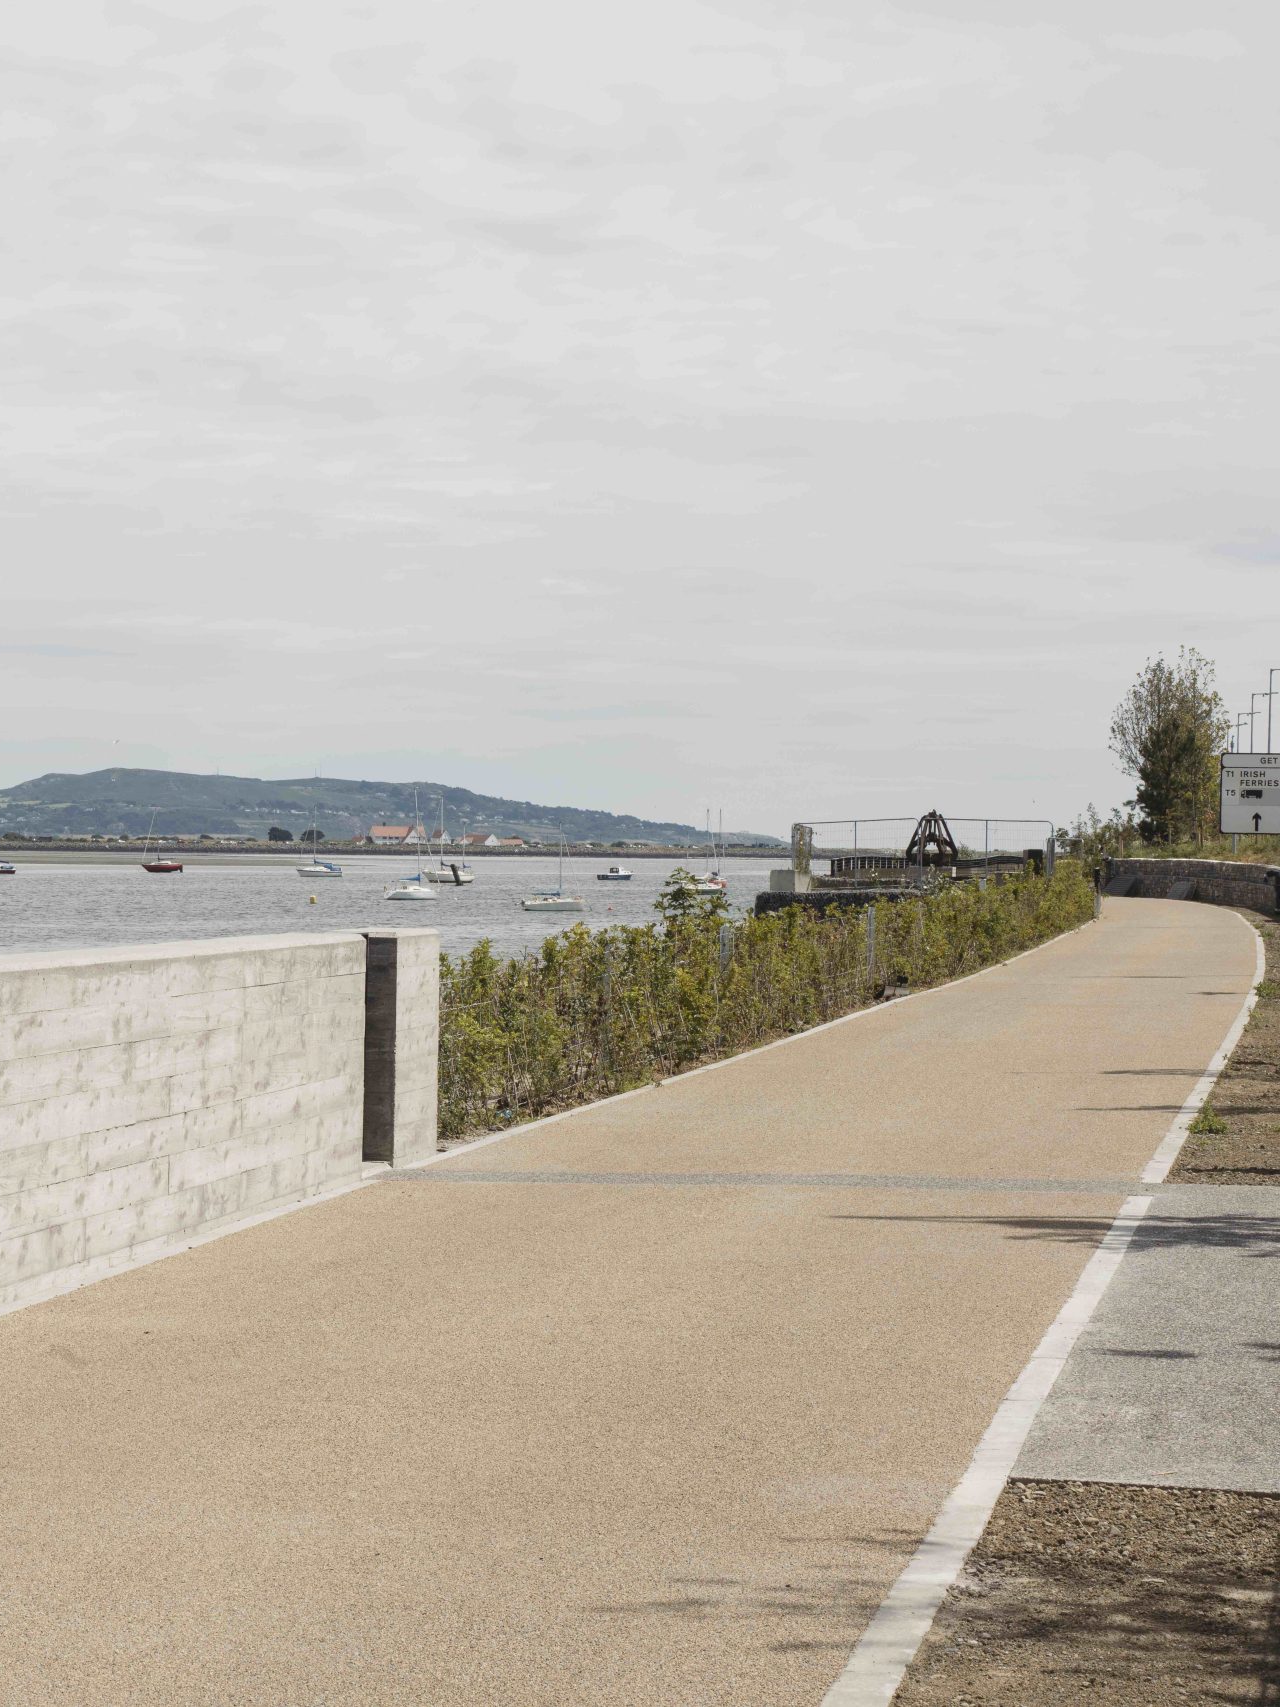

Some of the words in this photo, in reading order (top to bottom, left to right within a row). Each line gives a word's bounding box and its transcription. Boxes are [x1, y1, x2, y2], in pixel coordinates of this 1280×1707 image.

[1260, 757, 1278, 765] GET
[1225, 770, 1234, 778] T1
[1240, 770, 1266, 778] IRISH
[1240, 779, 1279, 787] FERRIES
[1225, 789, 1236, 797] T5
